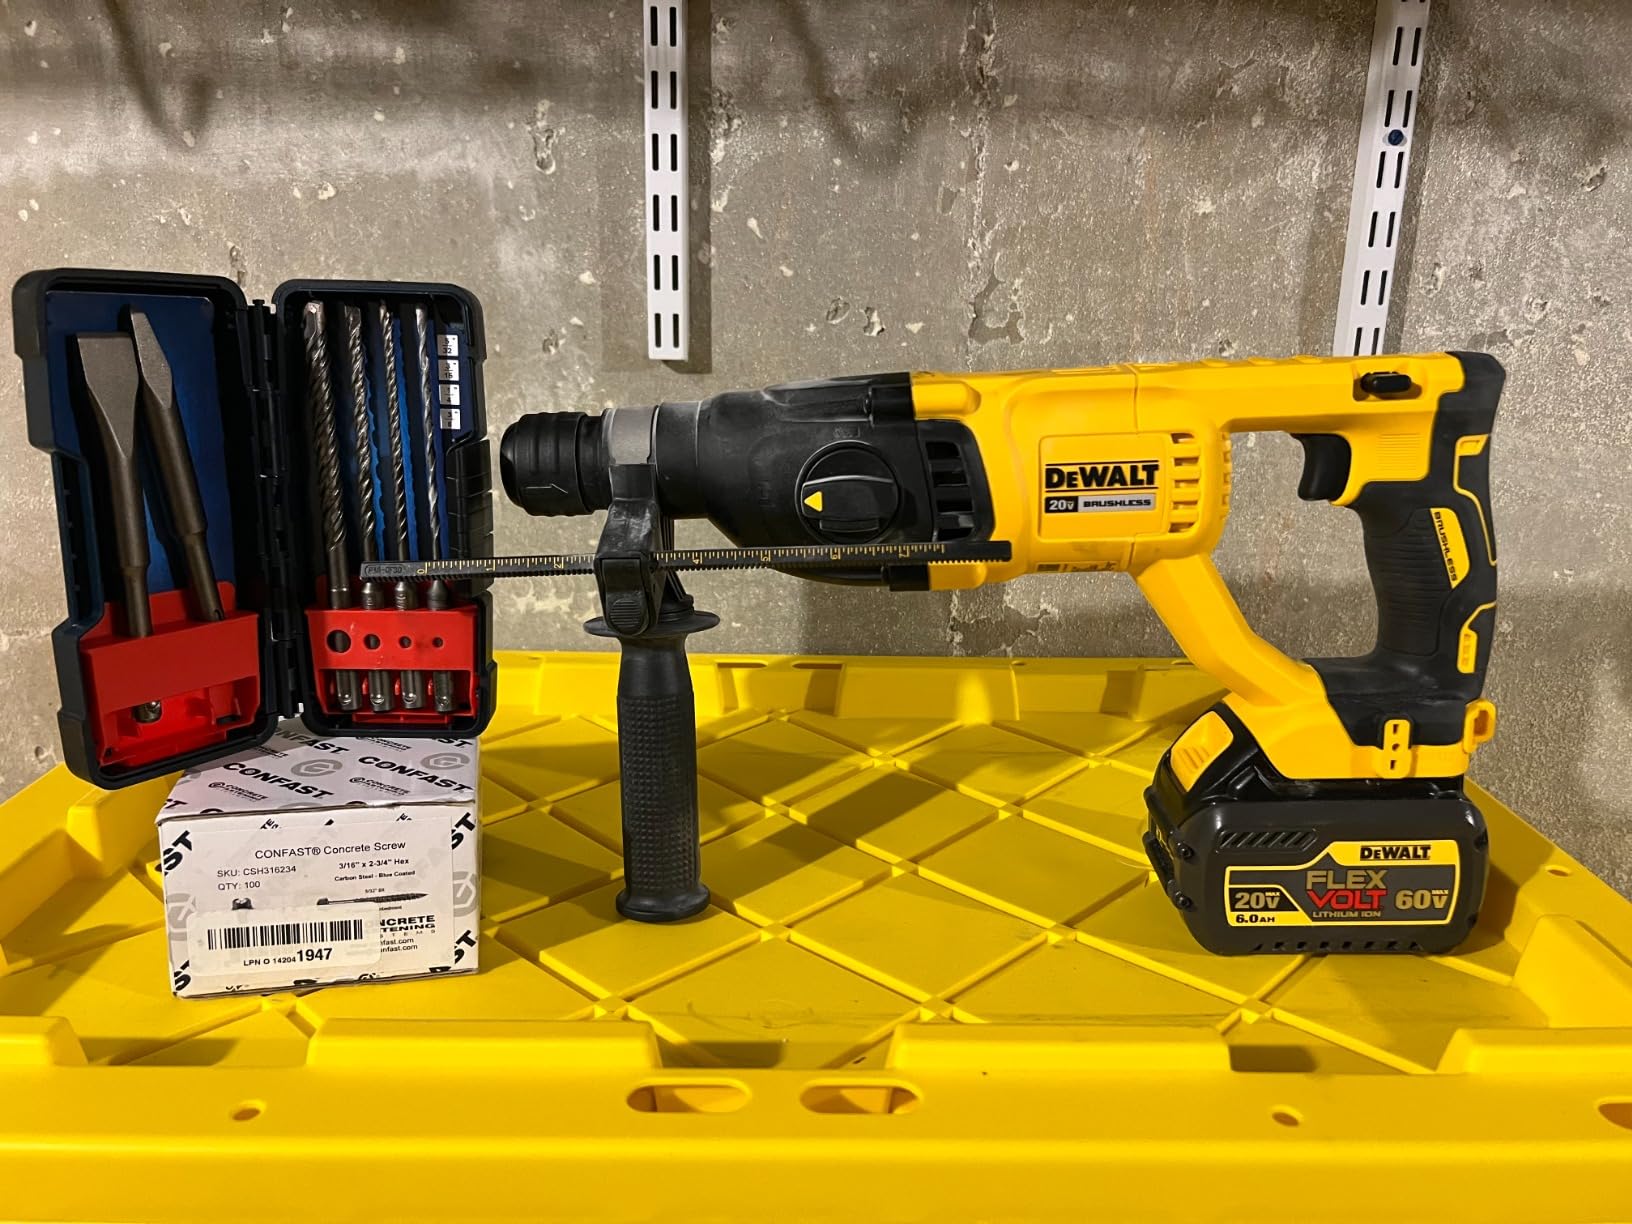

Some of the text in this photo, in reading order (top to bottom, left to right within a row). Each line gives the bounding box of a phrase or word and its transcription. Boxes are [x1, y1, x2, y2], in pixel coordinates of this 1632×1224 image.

[1045, 464, 1160, 489] DEWALT
[1083, 500, 1151, 508] BRUSHLESS
[1435, 512, 1457, 581] BRUSHLESS
[223, 762, 335, 800] CONFAST
[358, 756, 474, 792] CONFAST
[323, 843, 371, 855] Concrete
[374, 842, 406, 851] Screw
[1360, 845, 1430, 859] DEWALT
[368, 859, 392, 867] 2-3/4"
[217, 865, 296, 878] SKU: CSH316234
[217, 880, 260, 891] QTY: 100
[1306, 870, 1388, 889] FLEX
[1235, 892, 1280, 909] 20V
[1307, 890, 1387, 910] VOLT
[1395, 889, 1447, 910] 60V
[380, 915, 435, 926] NCRETE
[1236, 914, 1275, 923] 6.0AH
[380, 924, 435, 932] TENING
